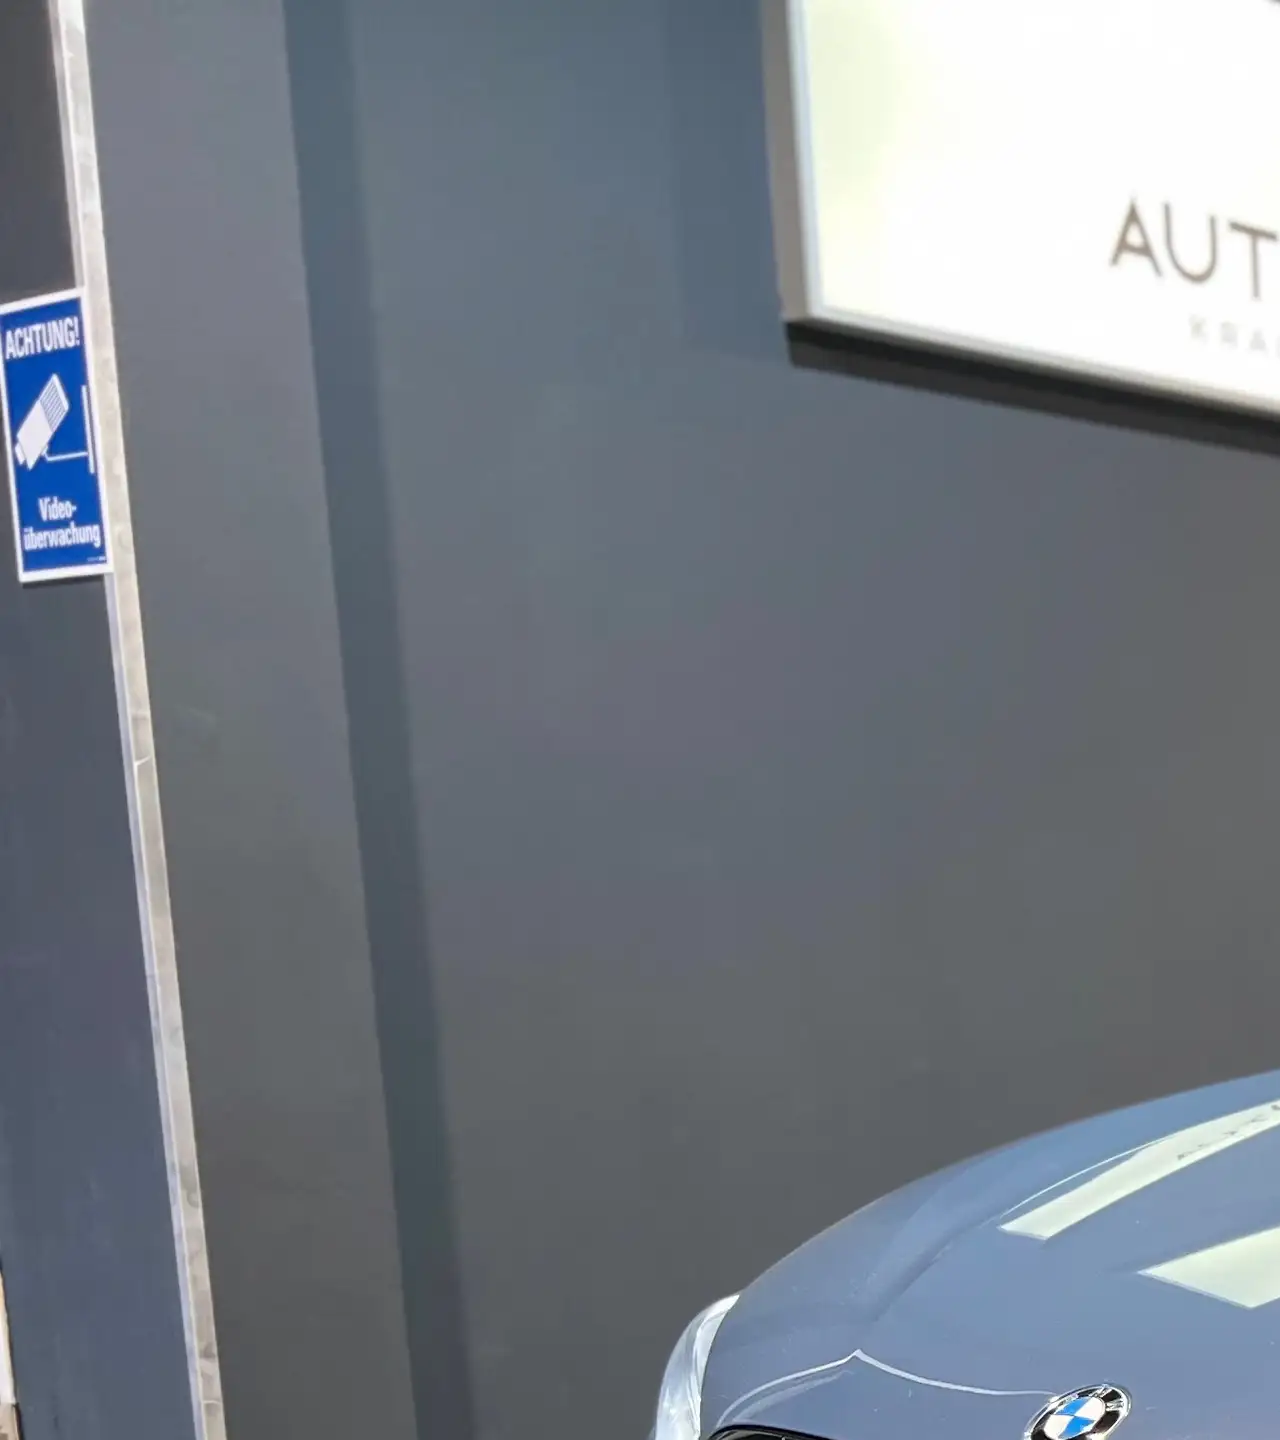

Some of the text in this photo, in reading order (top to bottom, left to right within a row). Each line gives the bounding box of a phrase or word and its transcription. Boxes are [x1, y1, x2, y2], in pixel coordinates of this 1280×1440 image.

[5, 315, 80, 360] ACHTUNG!
[38, 497, 77, 522] Video-
[24, 523, 101, 550] überwachung
